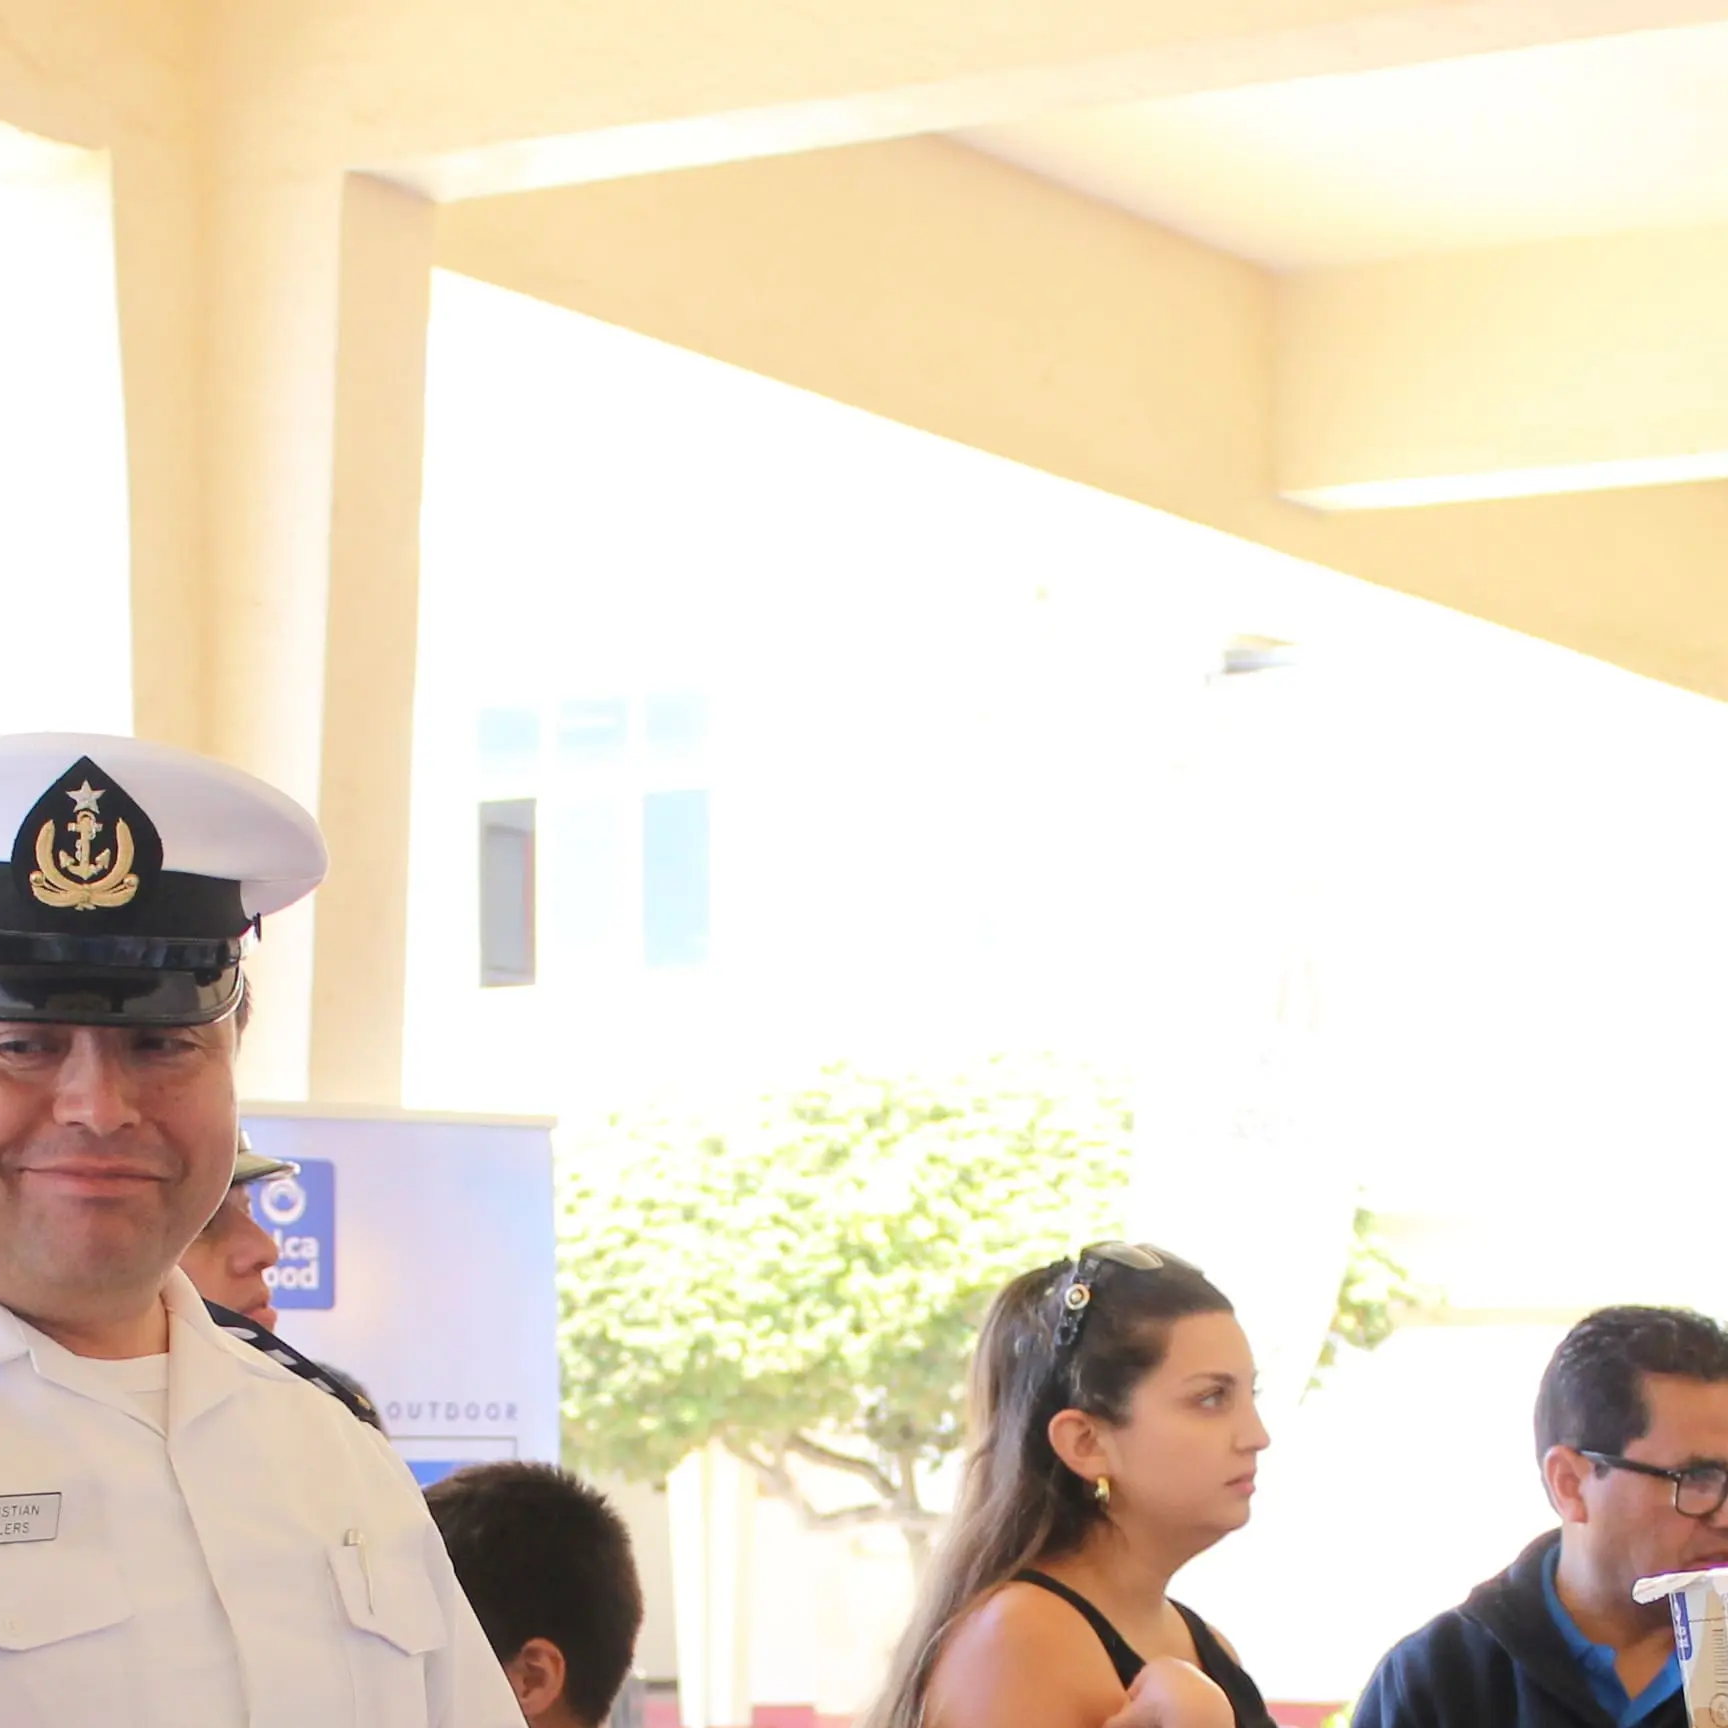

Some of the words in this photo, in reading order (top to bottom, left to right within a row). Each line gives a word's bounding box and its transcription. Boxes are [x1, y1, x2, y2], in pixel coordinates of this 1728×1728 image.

[273, 1229, 320, 1260] lca
[261, 1262, 320, 1290] ood
[384, 1401, 519, 1422] OUTDOOR
